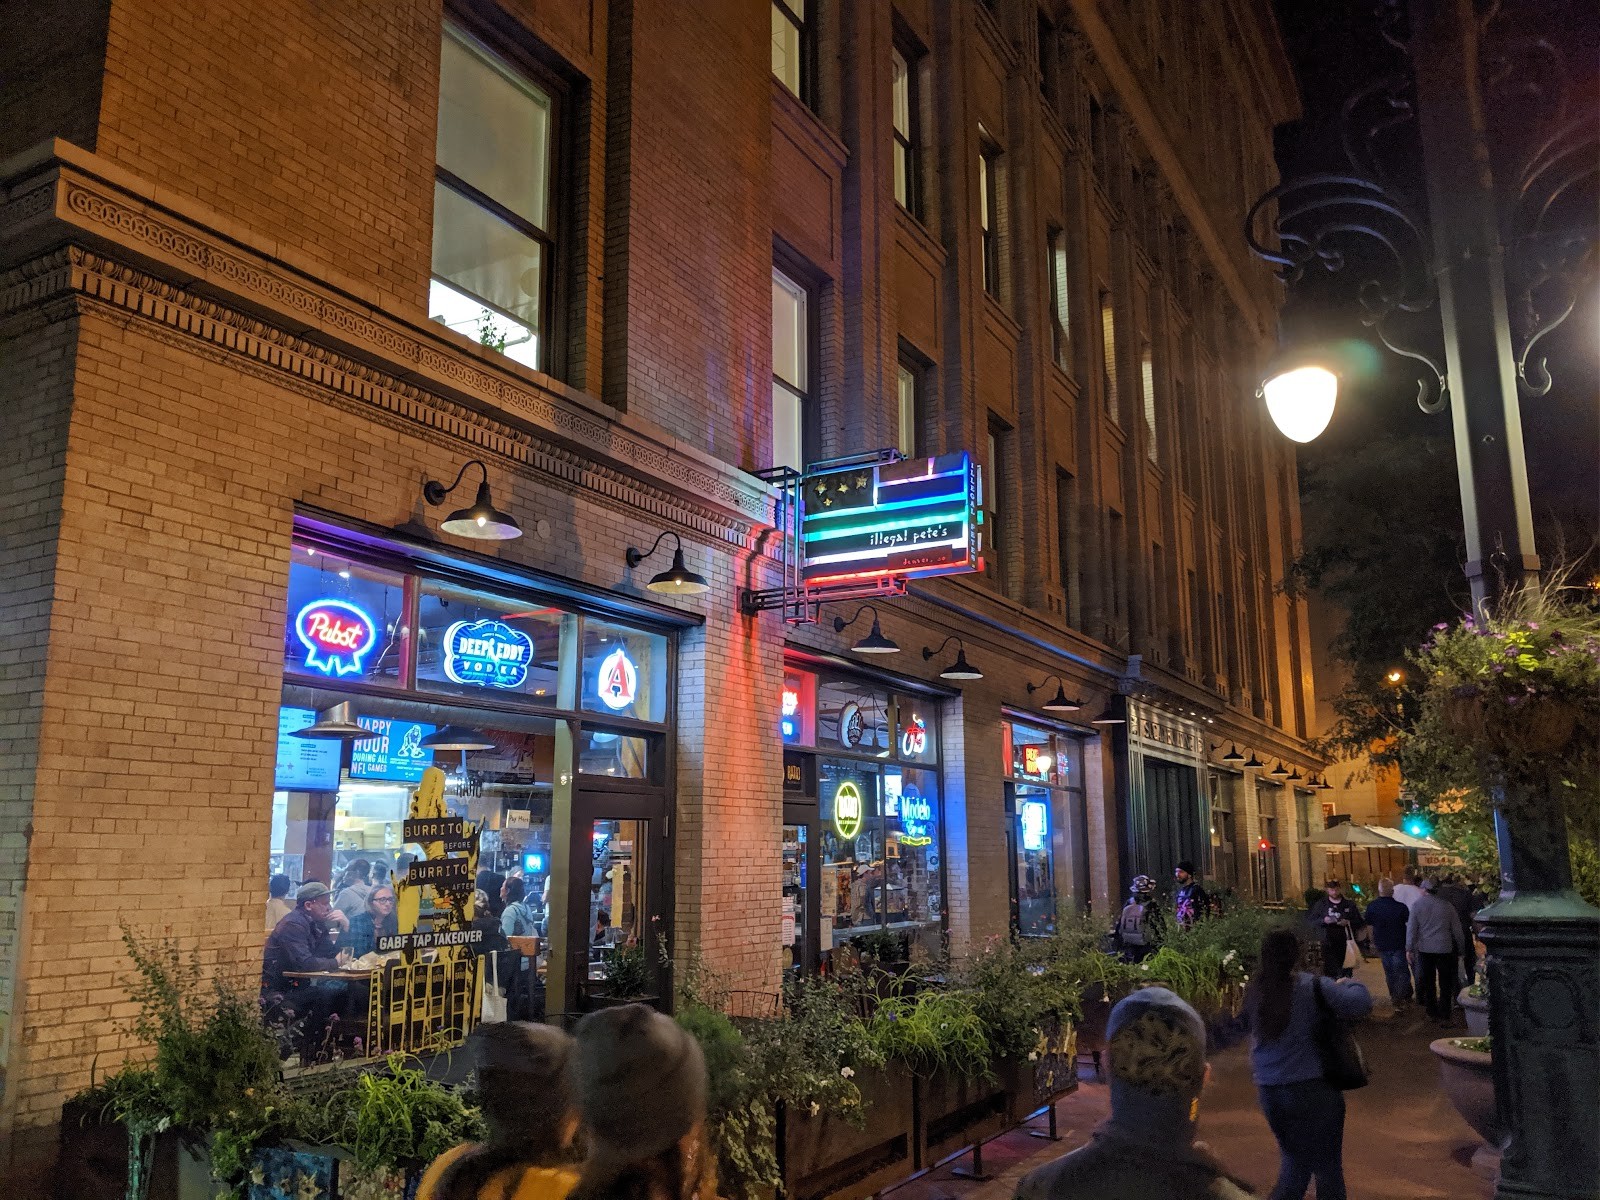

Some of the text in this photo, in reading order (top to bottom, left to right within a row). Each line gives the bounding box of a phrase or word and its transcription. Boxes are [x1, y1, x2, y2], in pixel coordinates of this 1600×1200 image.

[870, 524, 948, 546] illegal pete's
[308, 612, 363, 649] Pabst
[459, 637, 526, 661] DEEP EDDY
[463, 660, 517, 676] VODKA
[603, 653, 632, 698] A
[356, 716, 392, 735] HAPPY
[353, 736, 390, 754] HOUR
[352, 753, 376, 763] DURING
[377, 754, 388, 764] ALL
[351, 762, 366, 774] NFL
[367, 763, 387, 773] GAMES
[901, 795, 930, 821] Modelo
[404, 822, 463, 838] BURRITO
[445, 841, 471, 850] BEFORE
[410, 863, 468, 880] BURRITO
[452, 882, 475, 891] AFTER
[379, 930, 483, 950] GABF TAP TAKEOVER
